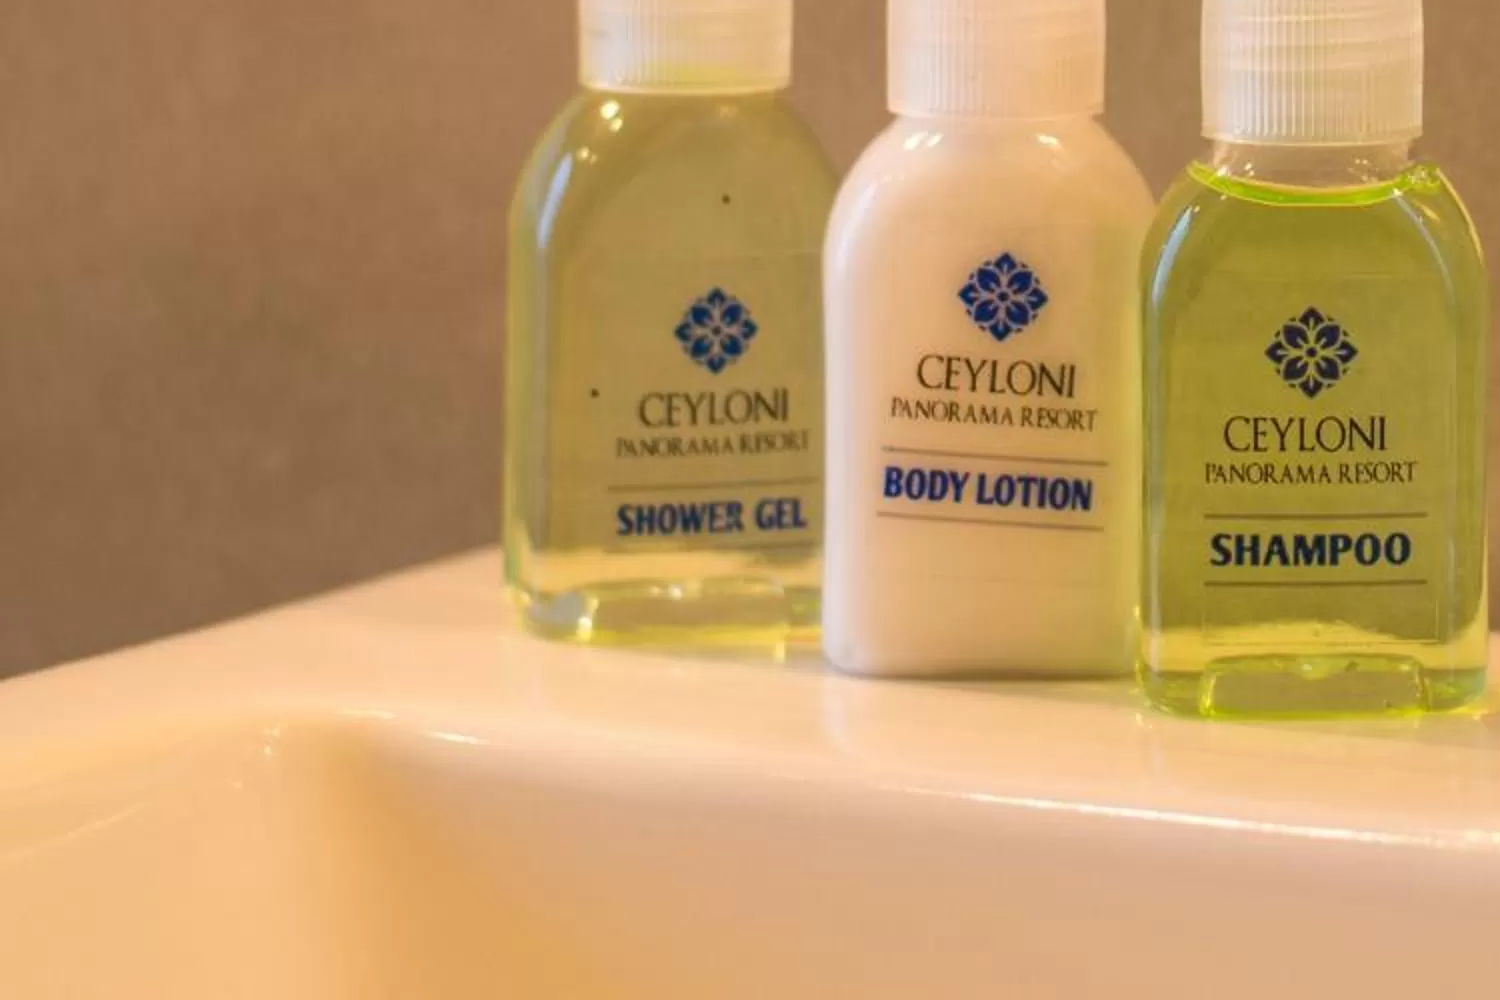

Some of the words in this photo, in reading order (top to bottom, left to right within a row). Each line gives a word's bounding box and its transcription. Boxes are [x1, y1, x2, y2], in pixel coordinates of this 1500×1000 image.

[917, 354, 1076, 398] CEYLONI
[638, 387, 789, 429] CEYLONI
[891, 397, 1013, 426] PANORAMA
[1021, 407, 1098, 431] RESORT
[616, 436, 734, 458] PANORAMA
[1223, 415, 1388, 452] CEYLONI
[883, 465, 970, 502] BODY
[976, 473, 1093, 511] LOTION
[1205, 461, 1331, 484] PANORAMA
[1339, 460, 1417, 484] RESORT
[616, 501, 744, 536] SHOWER
[755, 496, 807, 530] GEL
[1210, 532, 1411, 567] SHAMPOO
